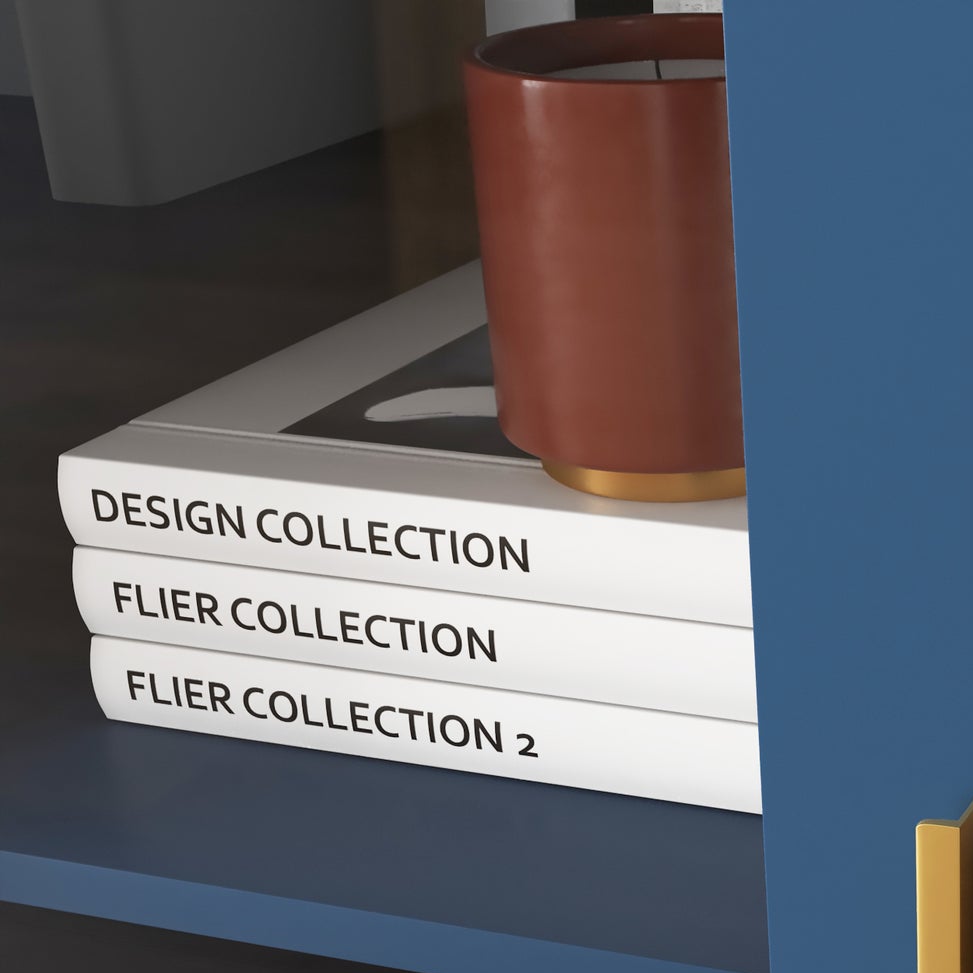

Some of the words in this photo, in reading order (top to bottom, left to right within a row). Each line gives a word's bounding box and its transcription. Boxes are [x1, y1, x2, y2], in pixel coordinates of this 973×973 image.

[92, 488, 247, 539] DESIGN
[256, 508, 530, 573] COLLECTION
[113, 581, 223, 627] FLIER
[230, 597, 497, 663] COLLECTION
[126, 670, 235, 715] FLIER
[242, 687, 503, 753] COLLECTION
[517, 733, 539, 758] 2
